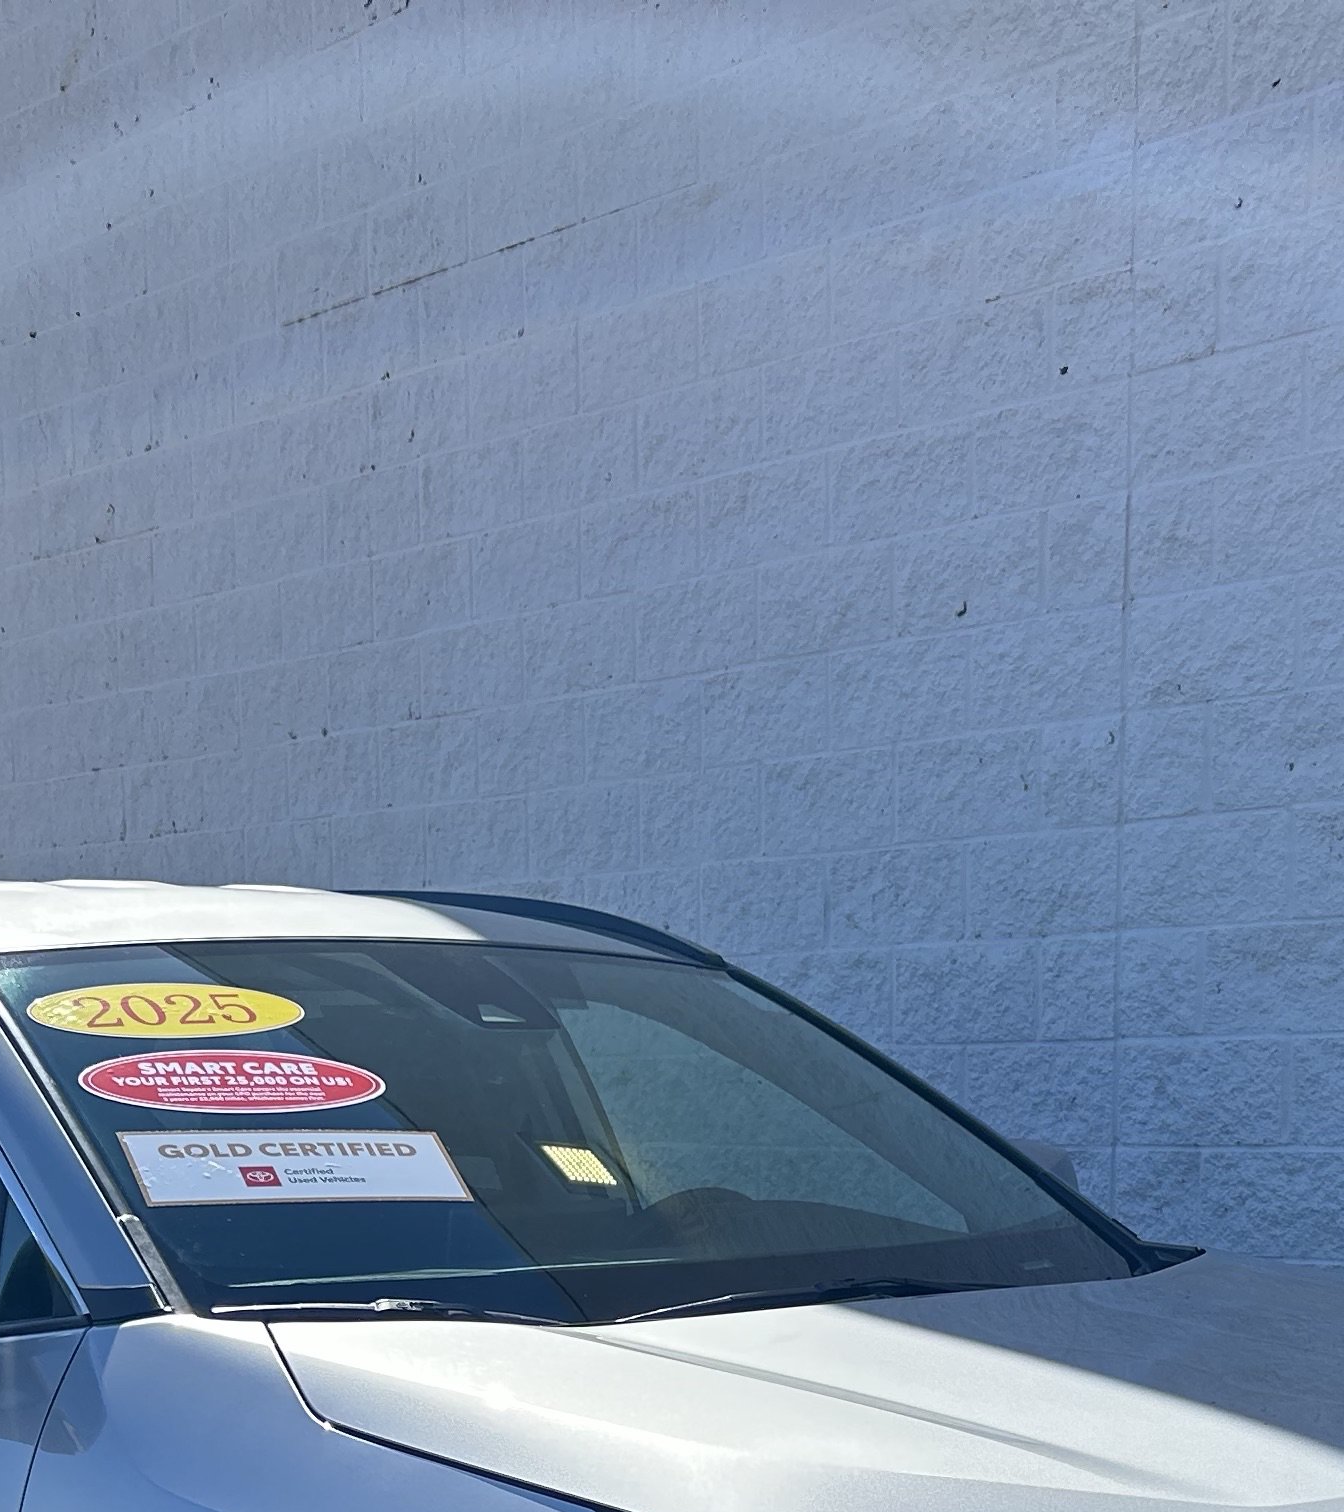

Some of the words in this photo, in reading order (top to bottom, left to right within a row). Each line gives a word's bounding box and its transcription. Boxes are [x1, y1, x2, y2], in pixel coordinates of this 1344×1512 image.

[73, 993, 256, 1028] 2025
[137, 1062, 236, 1075] SMART
[242, 1062, 318, 1075] CARE
[112, 1076, 169, 1087] YOUR
[170, 1076, 221, 1086] FIRST
[224, 1076, 287, 1087] 25,000
[289, 1076, 320, 1086] ON
[321, 1076, 353, 1087] US!
[158, 1143, 253, 1159] GOLD
[258, 1142, 417, 1158] CERTIFIED
[284, 1167, 335, 1176] Certified
[288, 1176, 318, 1184] Used
[319, 1175, 366, 1184] Vehicles
